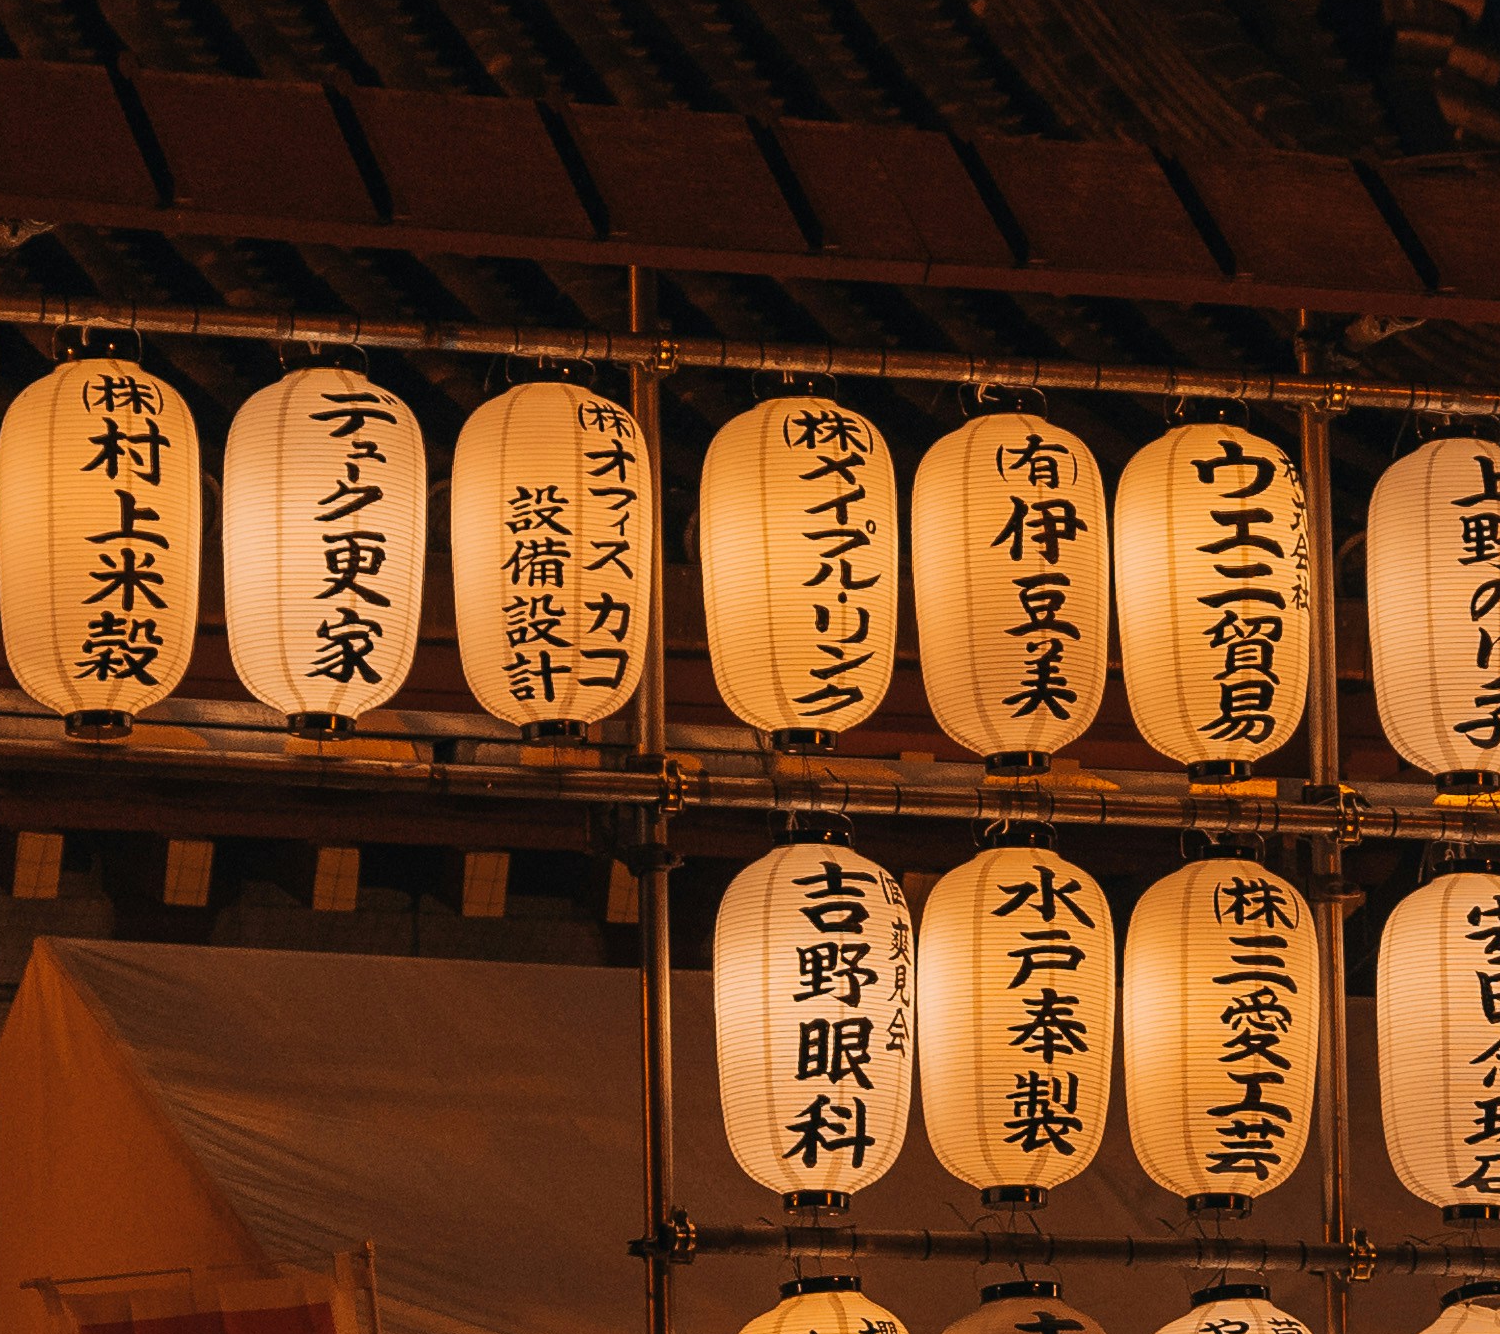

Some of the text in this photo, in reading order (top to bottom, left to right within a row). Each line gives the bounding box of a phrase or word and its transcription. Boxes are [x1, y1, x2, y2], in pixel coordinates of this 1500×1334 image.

[305, 392, 399, 685] デューク更家
[501, 485, 574, 704] 設備設計
[782, 860, 879, 1169] 吉野眼科
